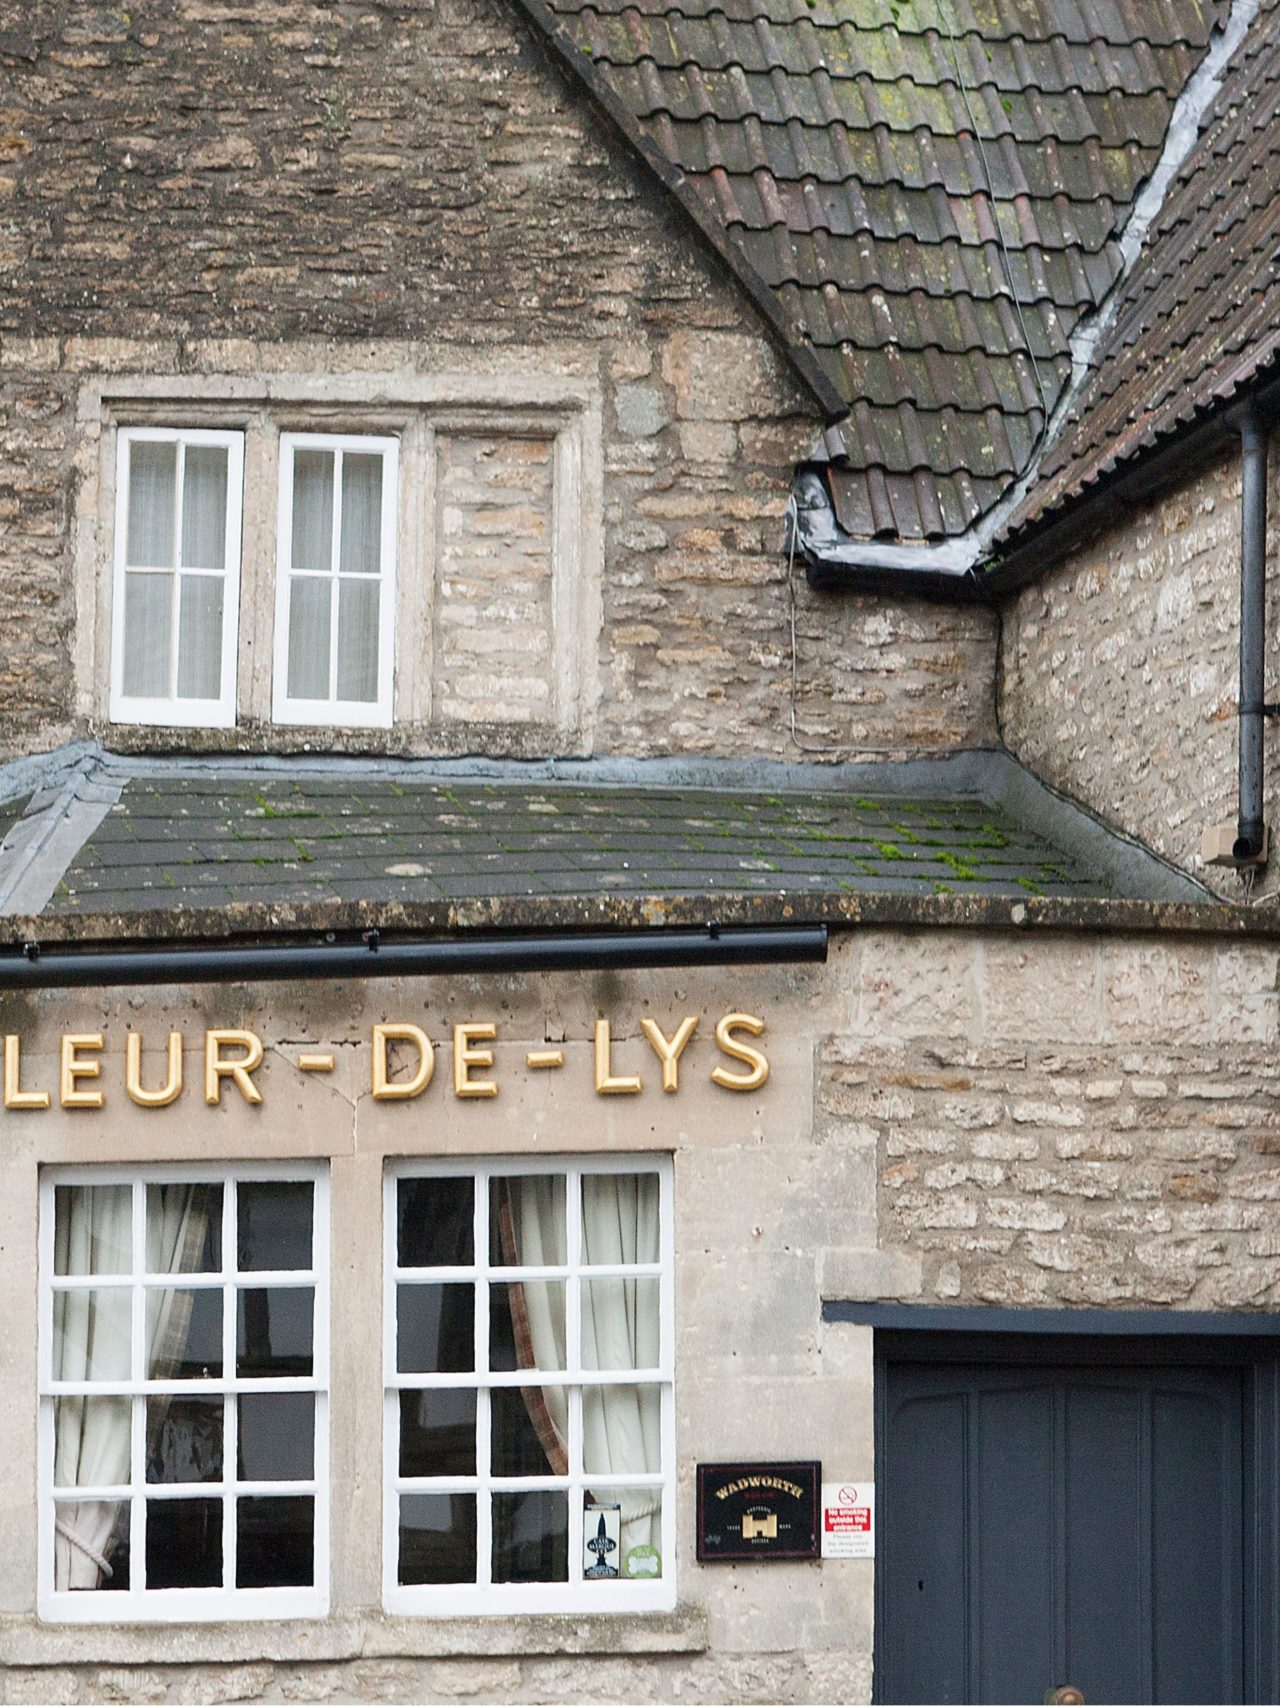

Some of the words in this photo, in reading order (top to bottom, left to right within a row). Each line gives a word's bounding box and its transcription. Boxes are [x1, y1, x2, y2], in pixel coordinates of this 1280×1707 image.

[715, 1475, 804, 1500] WADWORTH
[828, 1508, 838, 1516] No
[839, 1508, 867, 1517] smoking
[828, 1516, 853, 1524] outside
[854, 1516, 867, 1524] this
[833, 1524, 862, 1532] entrance
